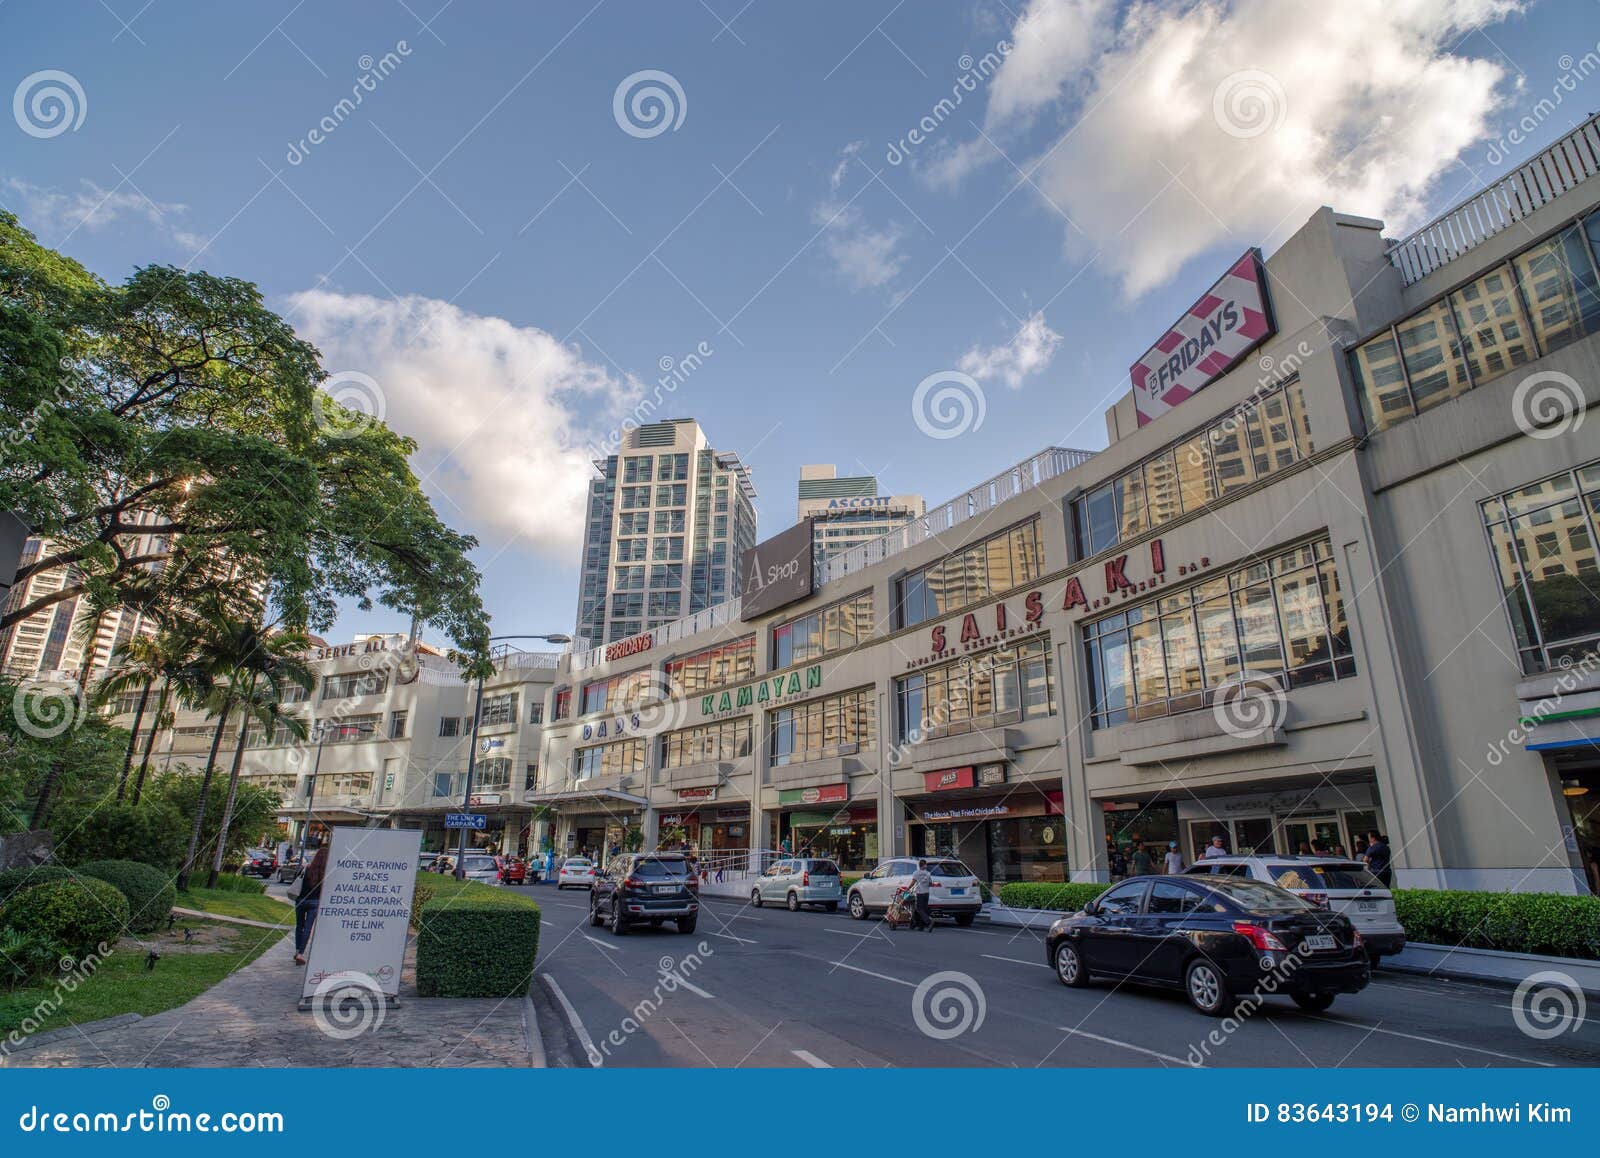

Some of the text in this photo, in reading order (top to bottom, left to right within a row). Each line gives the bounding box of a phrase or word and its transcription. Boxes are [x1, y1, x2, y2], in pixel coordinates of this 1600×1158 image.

[1149, 300, 1238, 400] TGI FRIDAYS
[828, 496, 891, 509] ASCOTT
[1178, 556, 1211, 576] BAR
[744, 551, 799, 594] A Shop
[931, 538, 1166, 652] SAISAKI
[317, 643, 358, 660] SERVE
[364, 639, 387, 654] ALL
[701, 664, 821, 716] KAMAYAN
[336, 859, 408, 871] MORE PARKING
[352, 871, 389, 882] SPACES
[334, 883, 403, 894] AVAILABLE AT
[329, 895, 403, 906] EDSA CARPARK
[319, 907, 409, 918] TERRACES SQUARE
[341, 919, 385, 930] THE LINK
[350, 932, 372, 942] 6750
